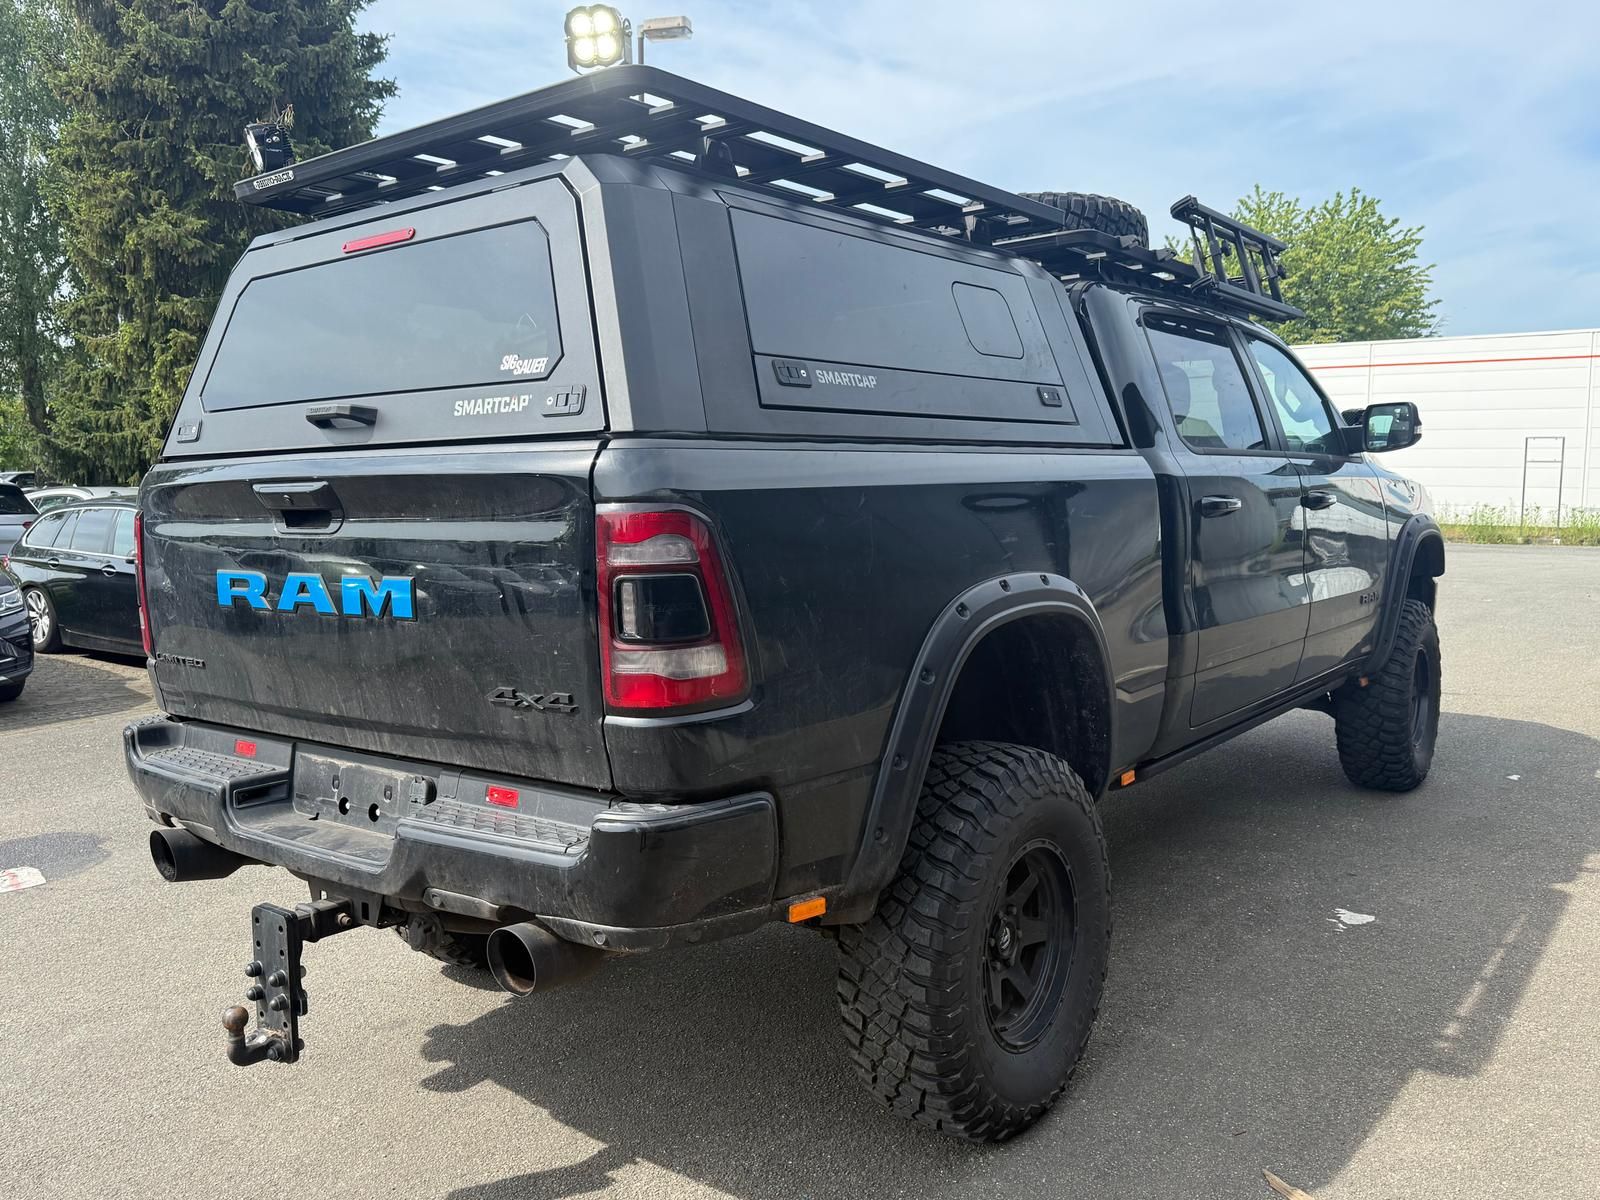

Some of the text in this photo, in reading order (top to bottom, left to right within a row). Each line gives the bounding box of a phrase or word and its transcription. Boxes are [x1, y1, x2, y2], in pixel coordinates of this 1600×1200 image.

[500, 354, 549, 375] SIG SAUER
[816, 369, 877, 389] SMARTCAP
[454, 394, 530, 416] SMARTCAP
[216, 569, 417, 621] RAM
